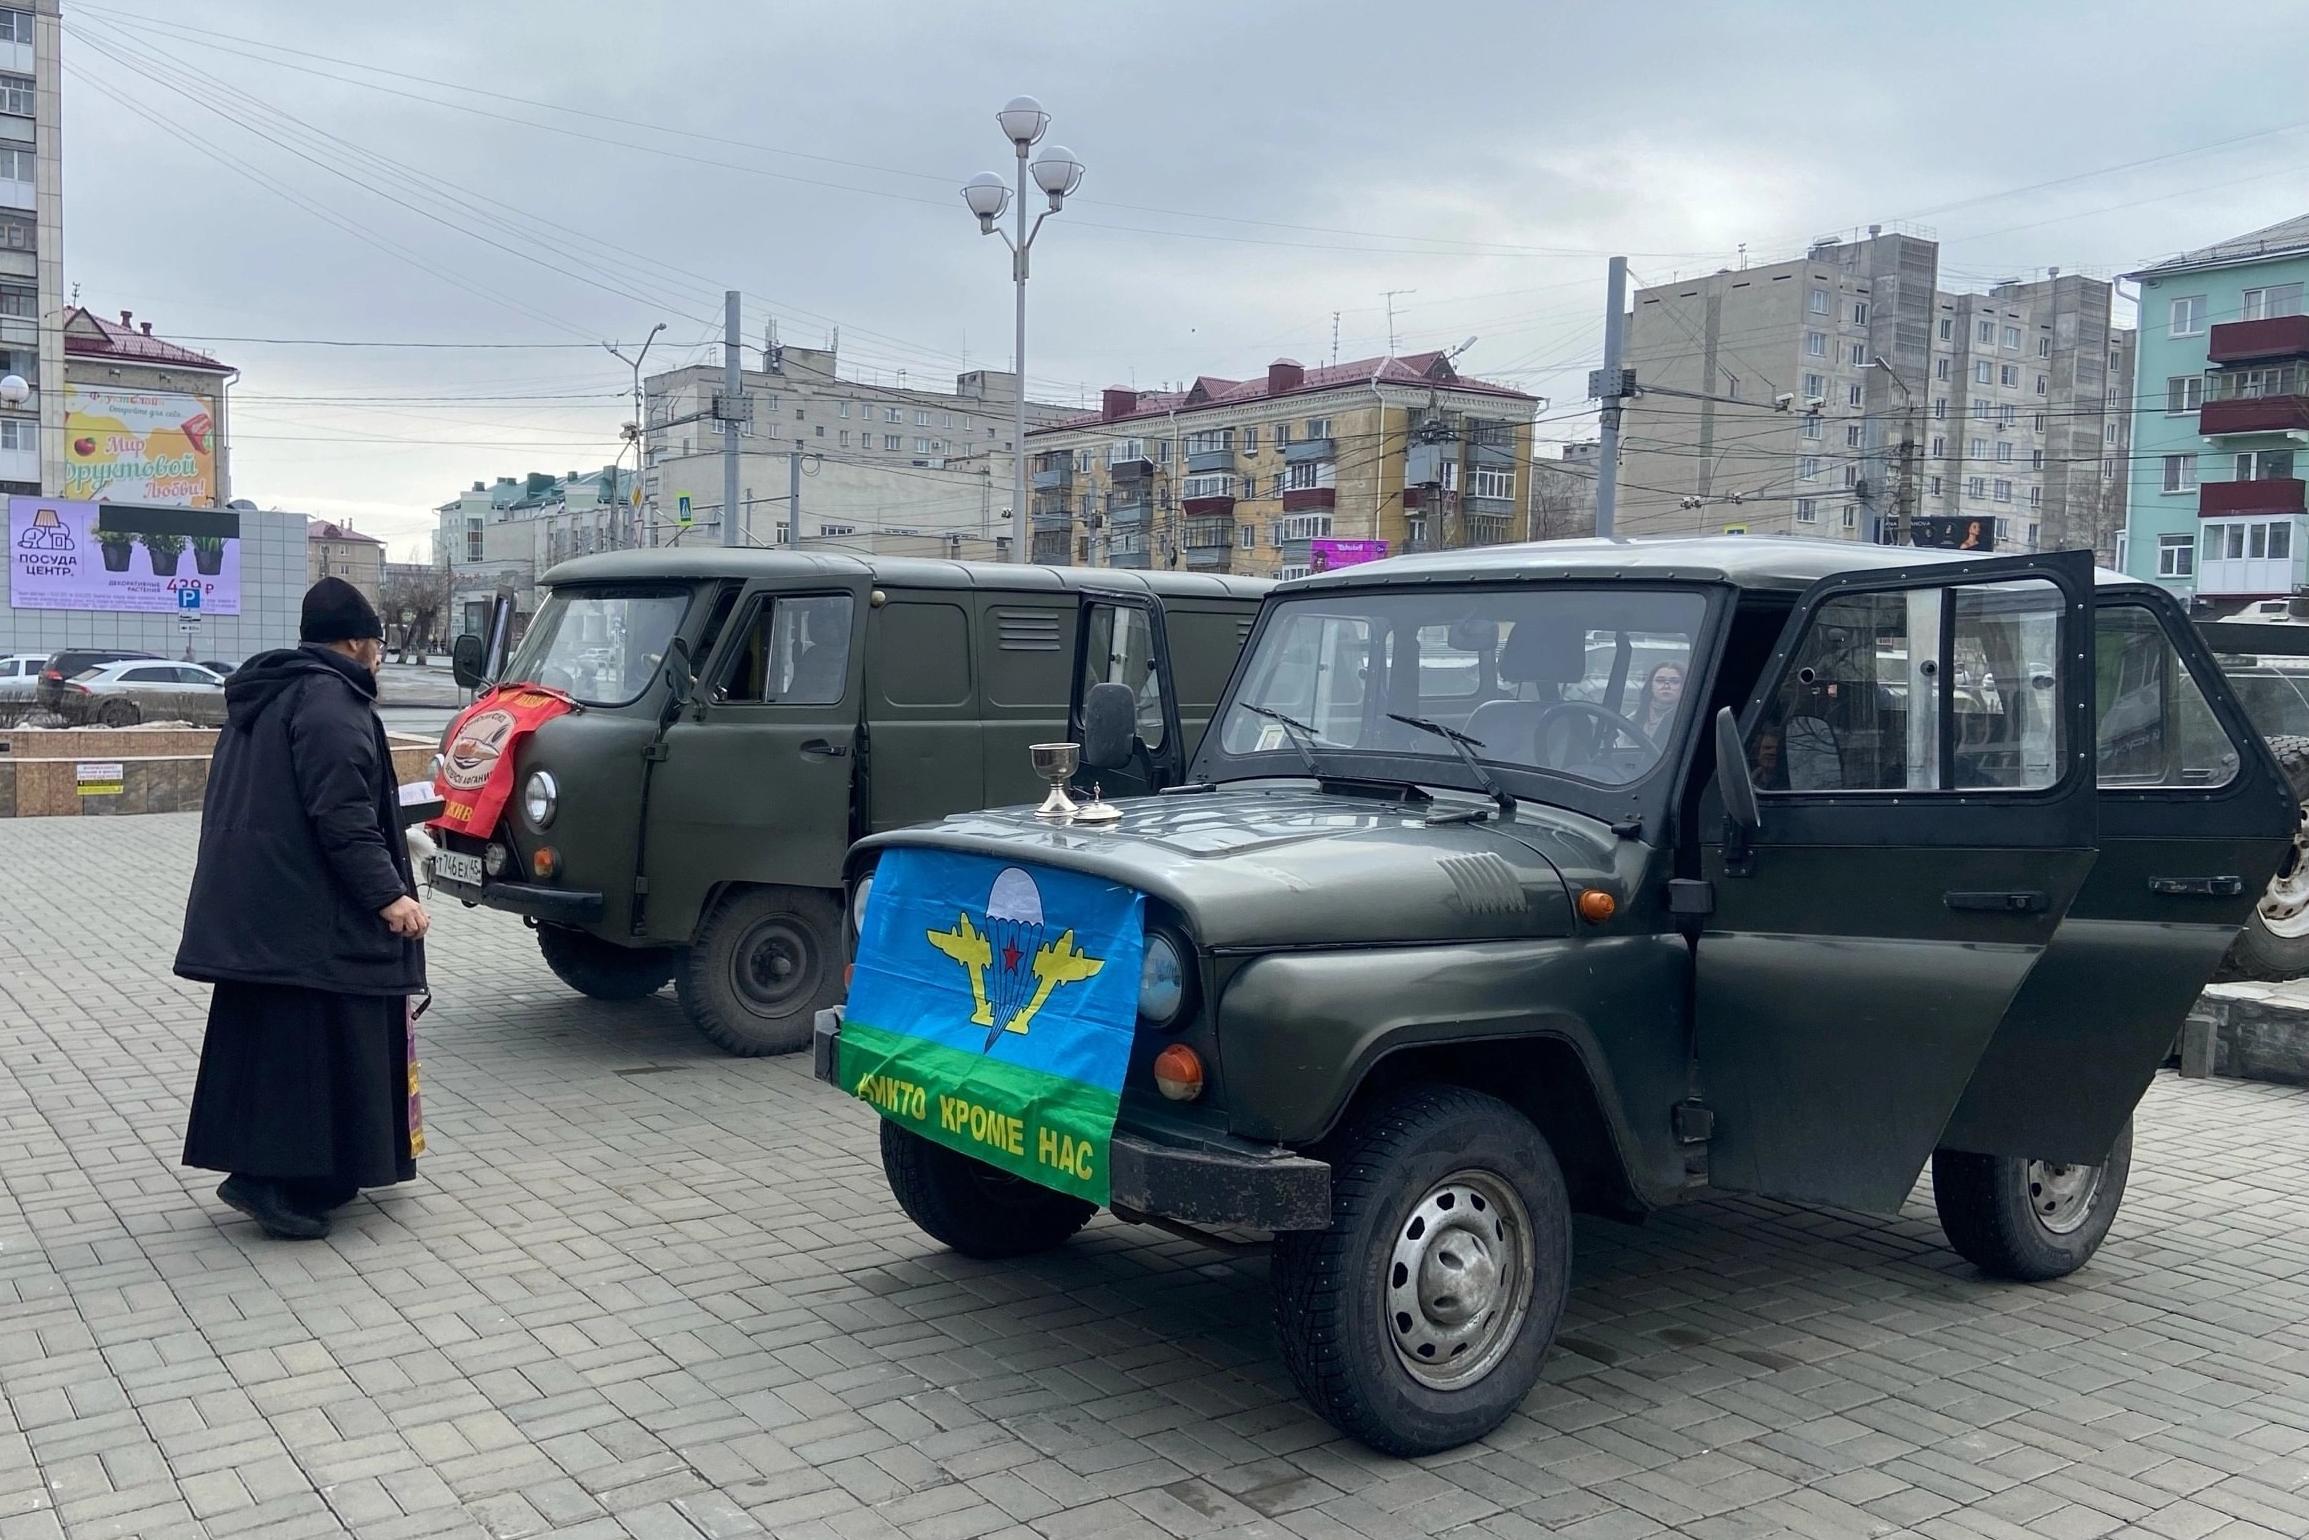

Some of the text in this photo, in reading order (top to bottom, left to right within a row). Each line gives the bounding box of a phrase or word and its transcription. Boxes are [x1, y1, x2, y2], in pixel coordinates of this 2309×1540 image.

[106, 436, 145, 457] Мир
[143, 481, 204, 498] Любви!
[20, 554, 77, 565] ПОСУДА
[939, 1094, 1024, 1156] КРОМЕ
[1039, 1126, 1094, 1181] НАС
